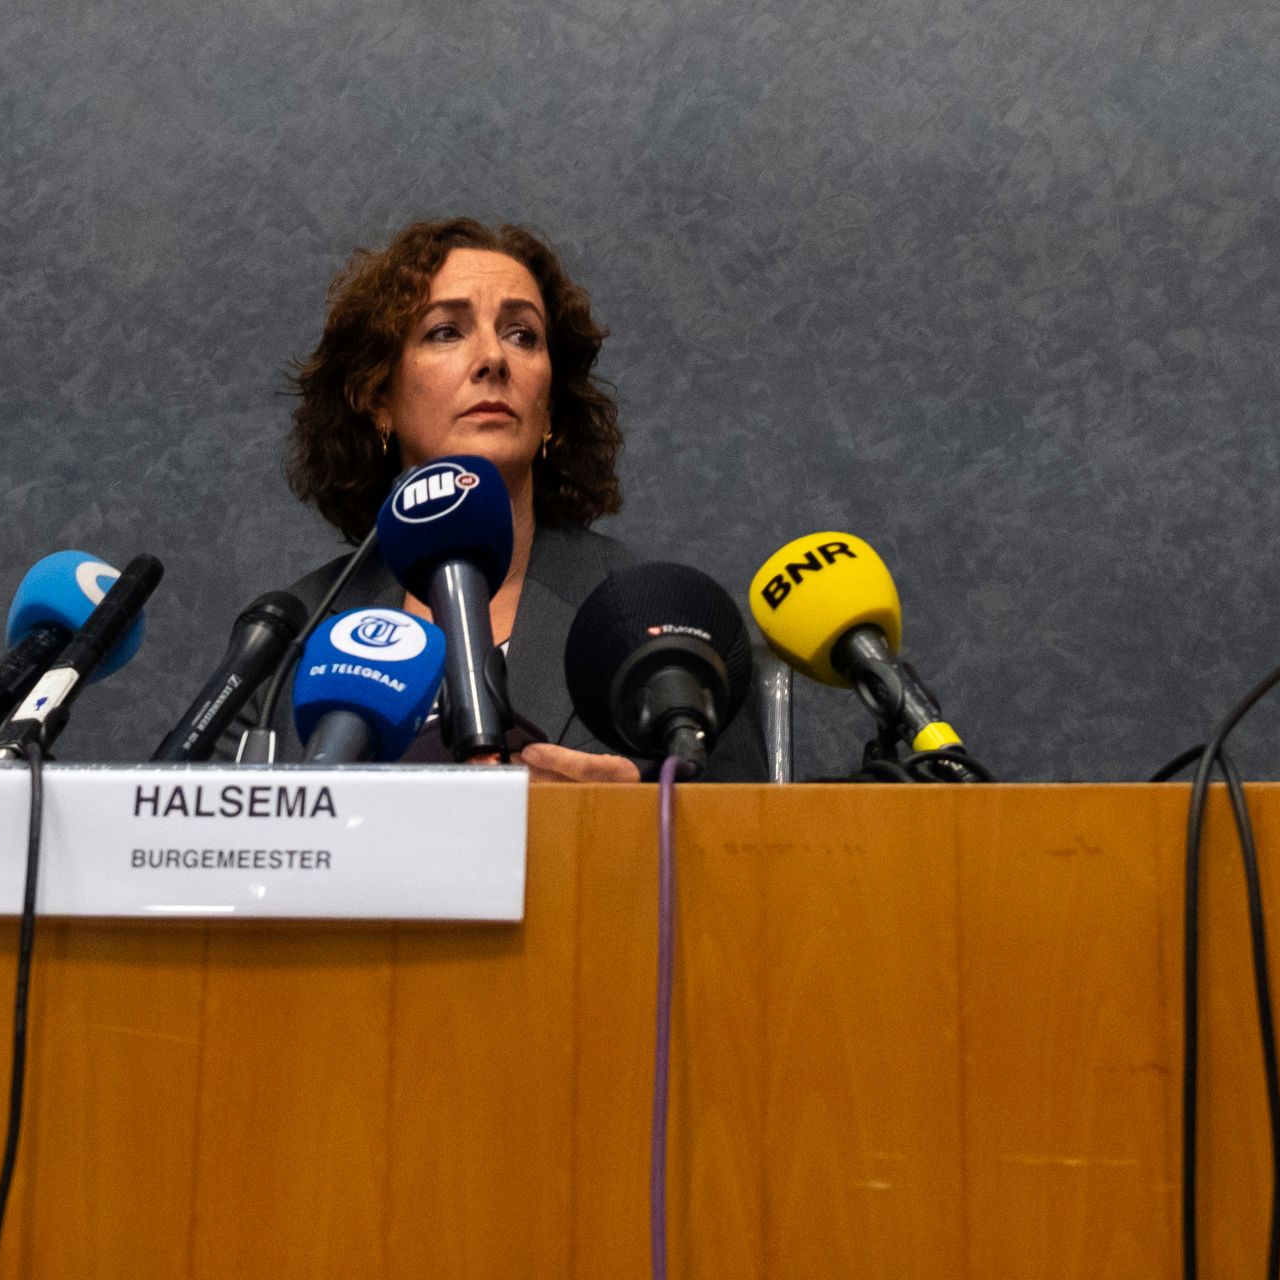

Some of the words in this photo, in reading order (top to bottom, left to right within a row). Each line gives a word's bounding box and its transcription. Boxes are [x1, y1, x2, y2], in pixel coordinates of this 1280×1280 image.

[403, 471, 456, 511] nu
[761, 542, 858, 611] BNR
[309, 664, 328, 677] DE
[331, 662, 407, 693] TELEGRAAF
[133, 785, 338, 819] HALSEMA
[131, 849, 332, 870] BURGEMEESTER
